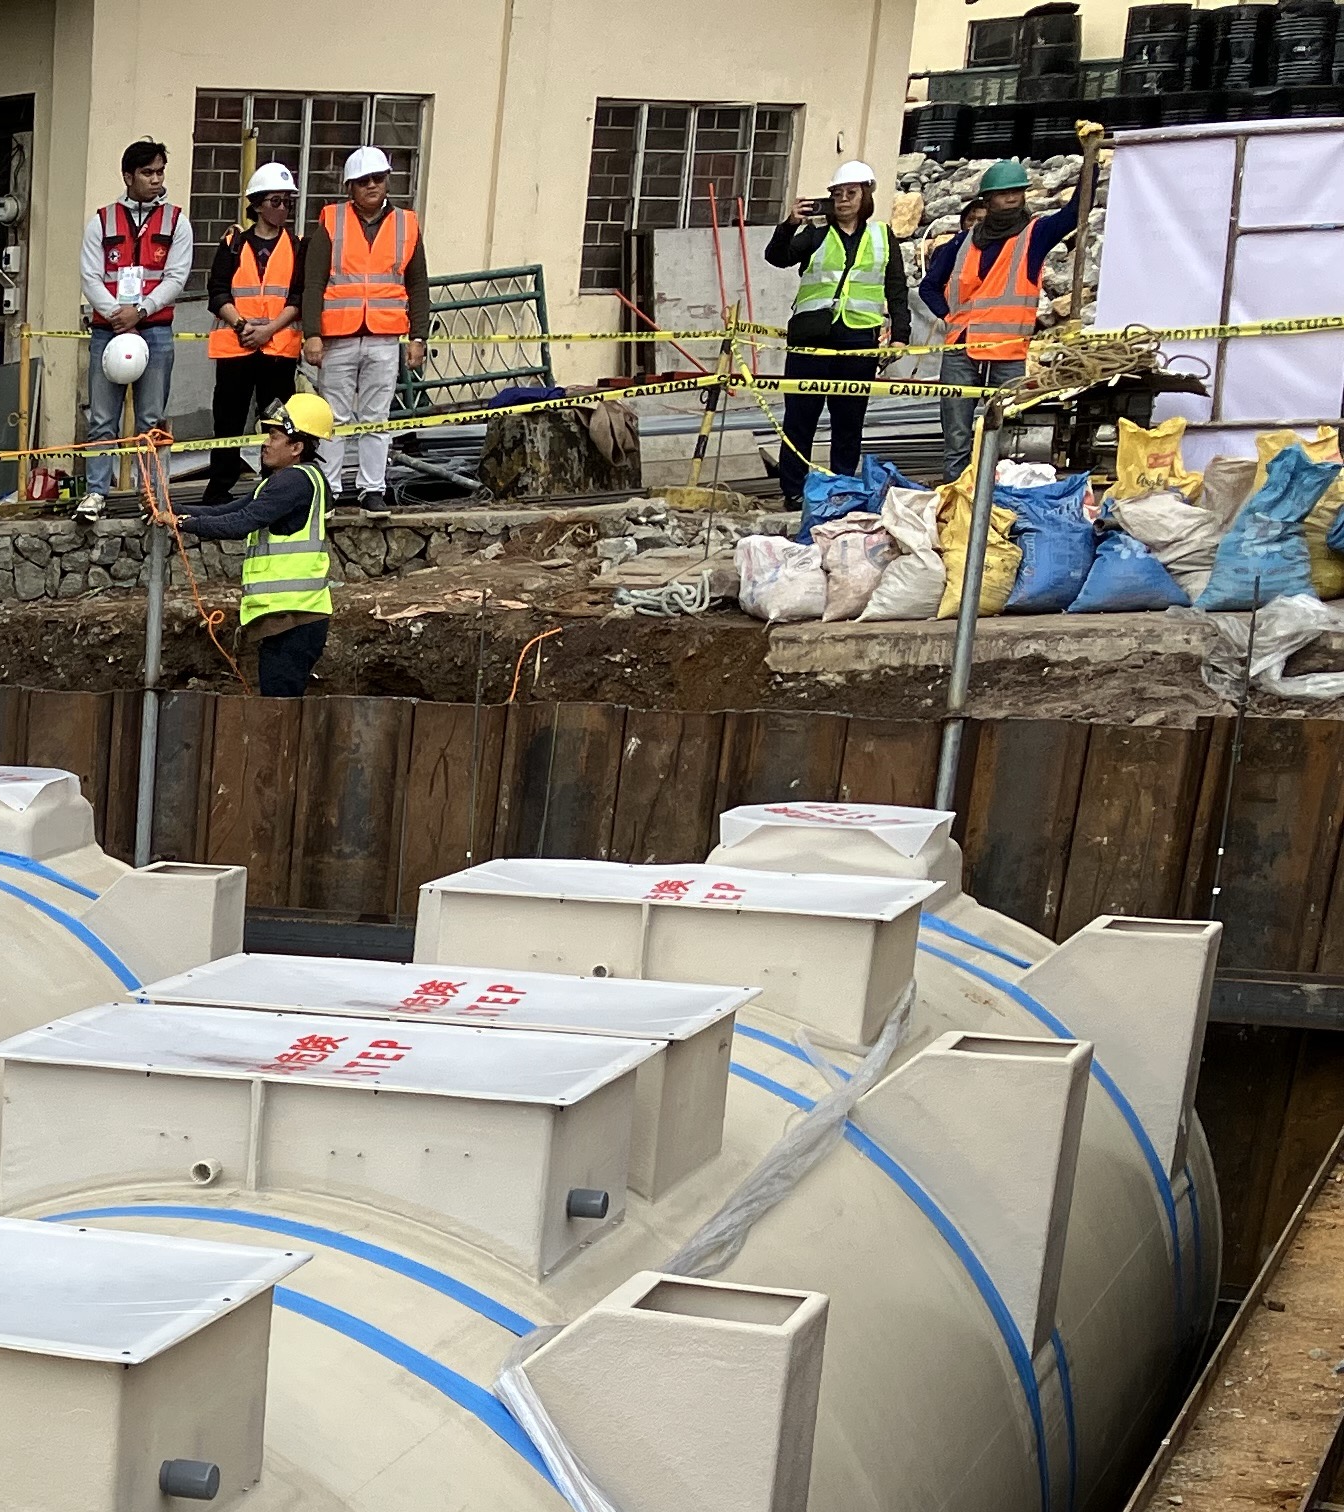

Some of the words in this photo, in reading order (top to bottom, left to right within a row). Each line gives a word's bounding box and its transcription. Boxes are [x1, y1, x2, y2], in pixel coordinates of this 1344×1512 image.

[623, 380, 698, 398] CAUTION
[797, 380, 872, 395] CAUTION
[889, 384, 963, 399] CAUTION
[333, 1039, 413, 1076] STEP
